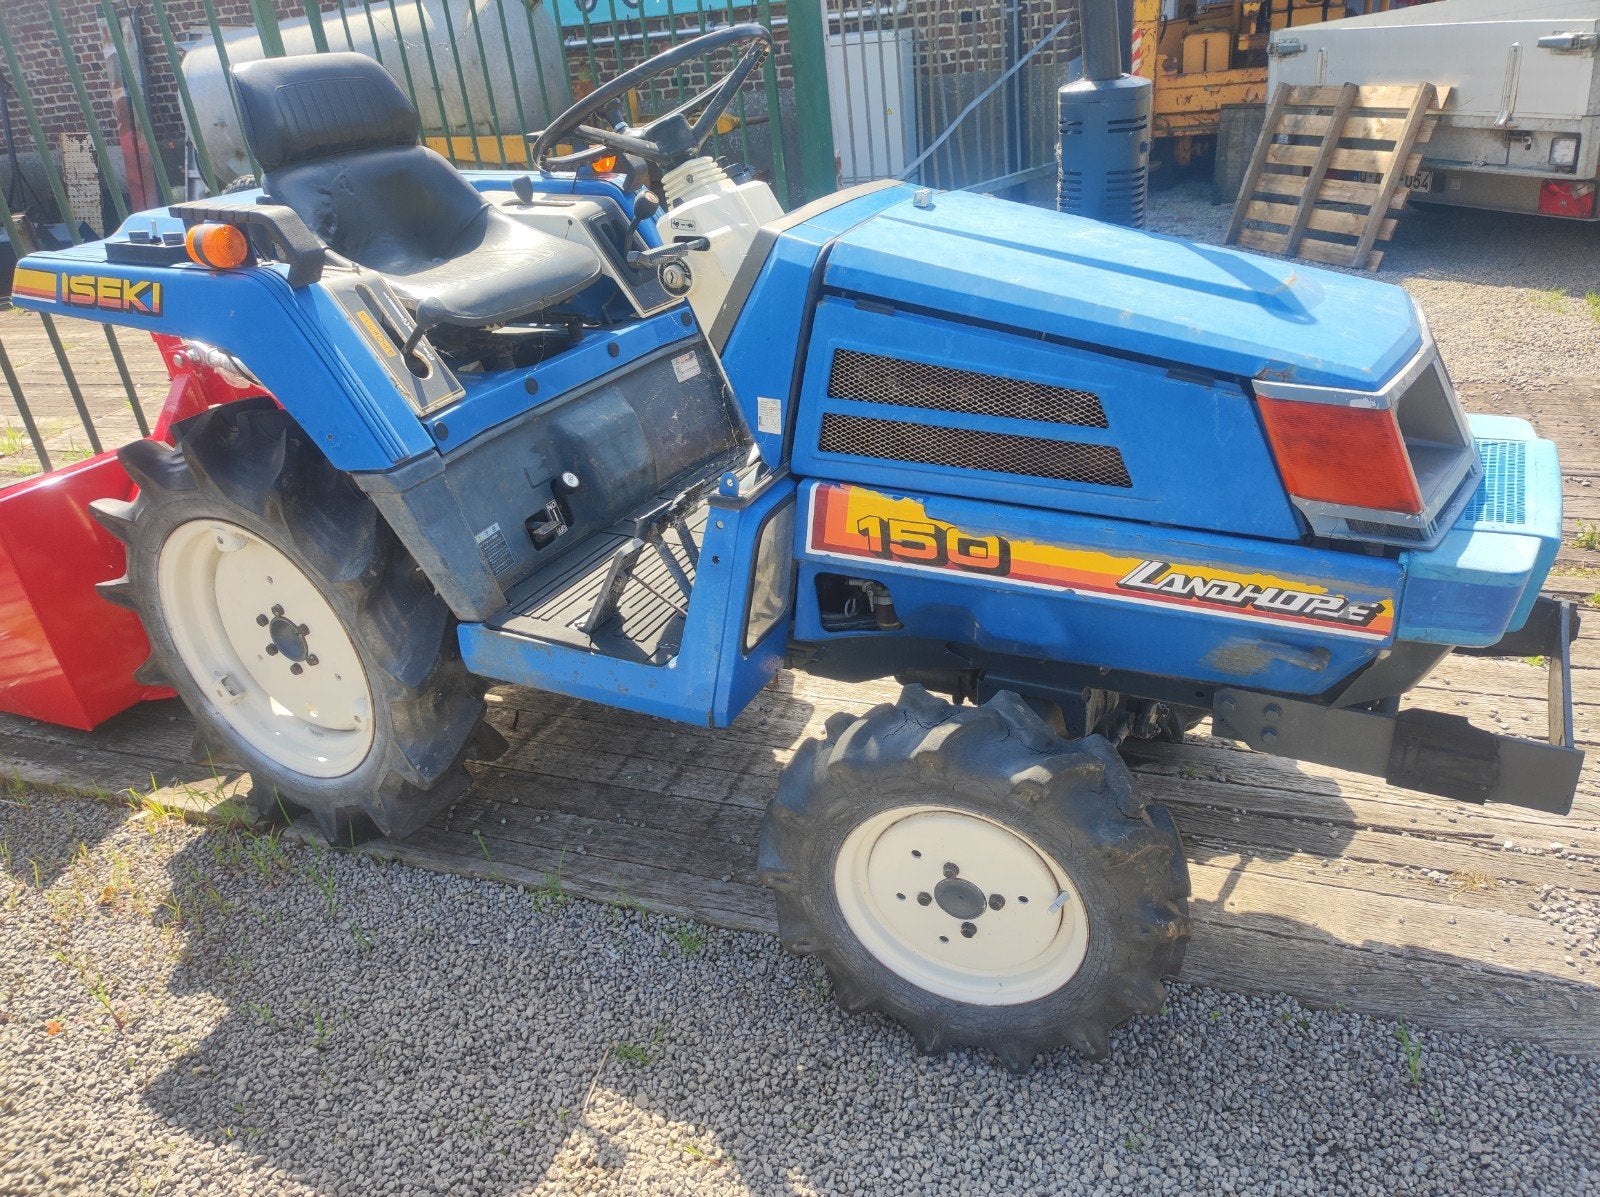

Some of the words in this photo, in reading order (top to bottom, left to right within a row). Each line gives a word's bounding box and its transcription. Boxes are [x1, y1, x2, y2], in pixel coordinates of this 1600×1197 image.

[61, 272, 163, 317] ISEKI
[857, 515, 1011, 577] 150
[1116, 560, 1385, 627] LANDHOPE
